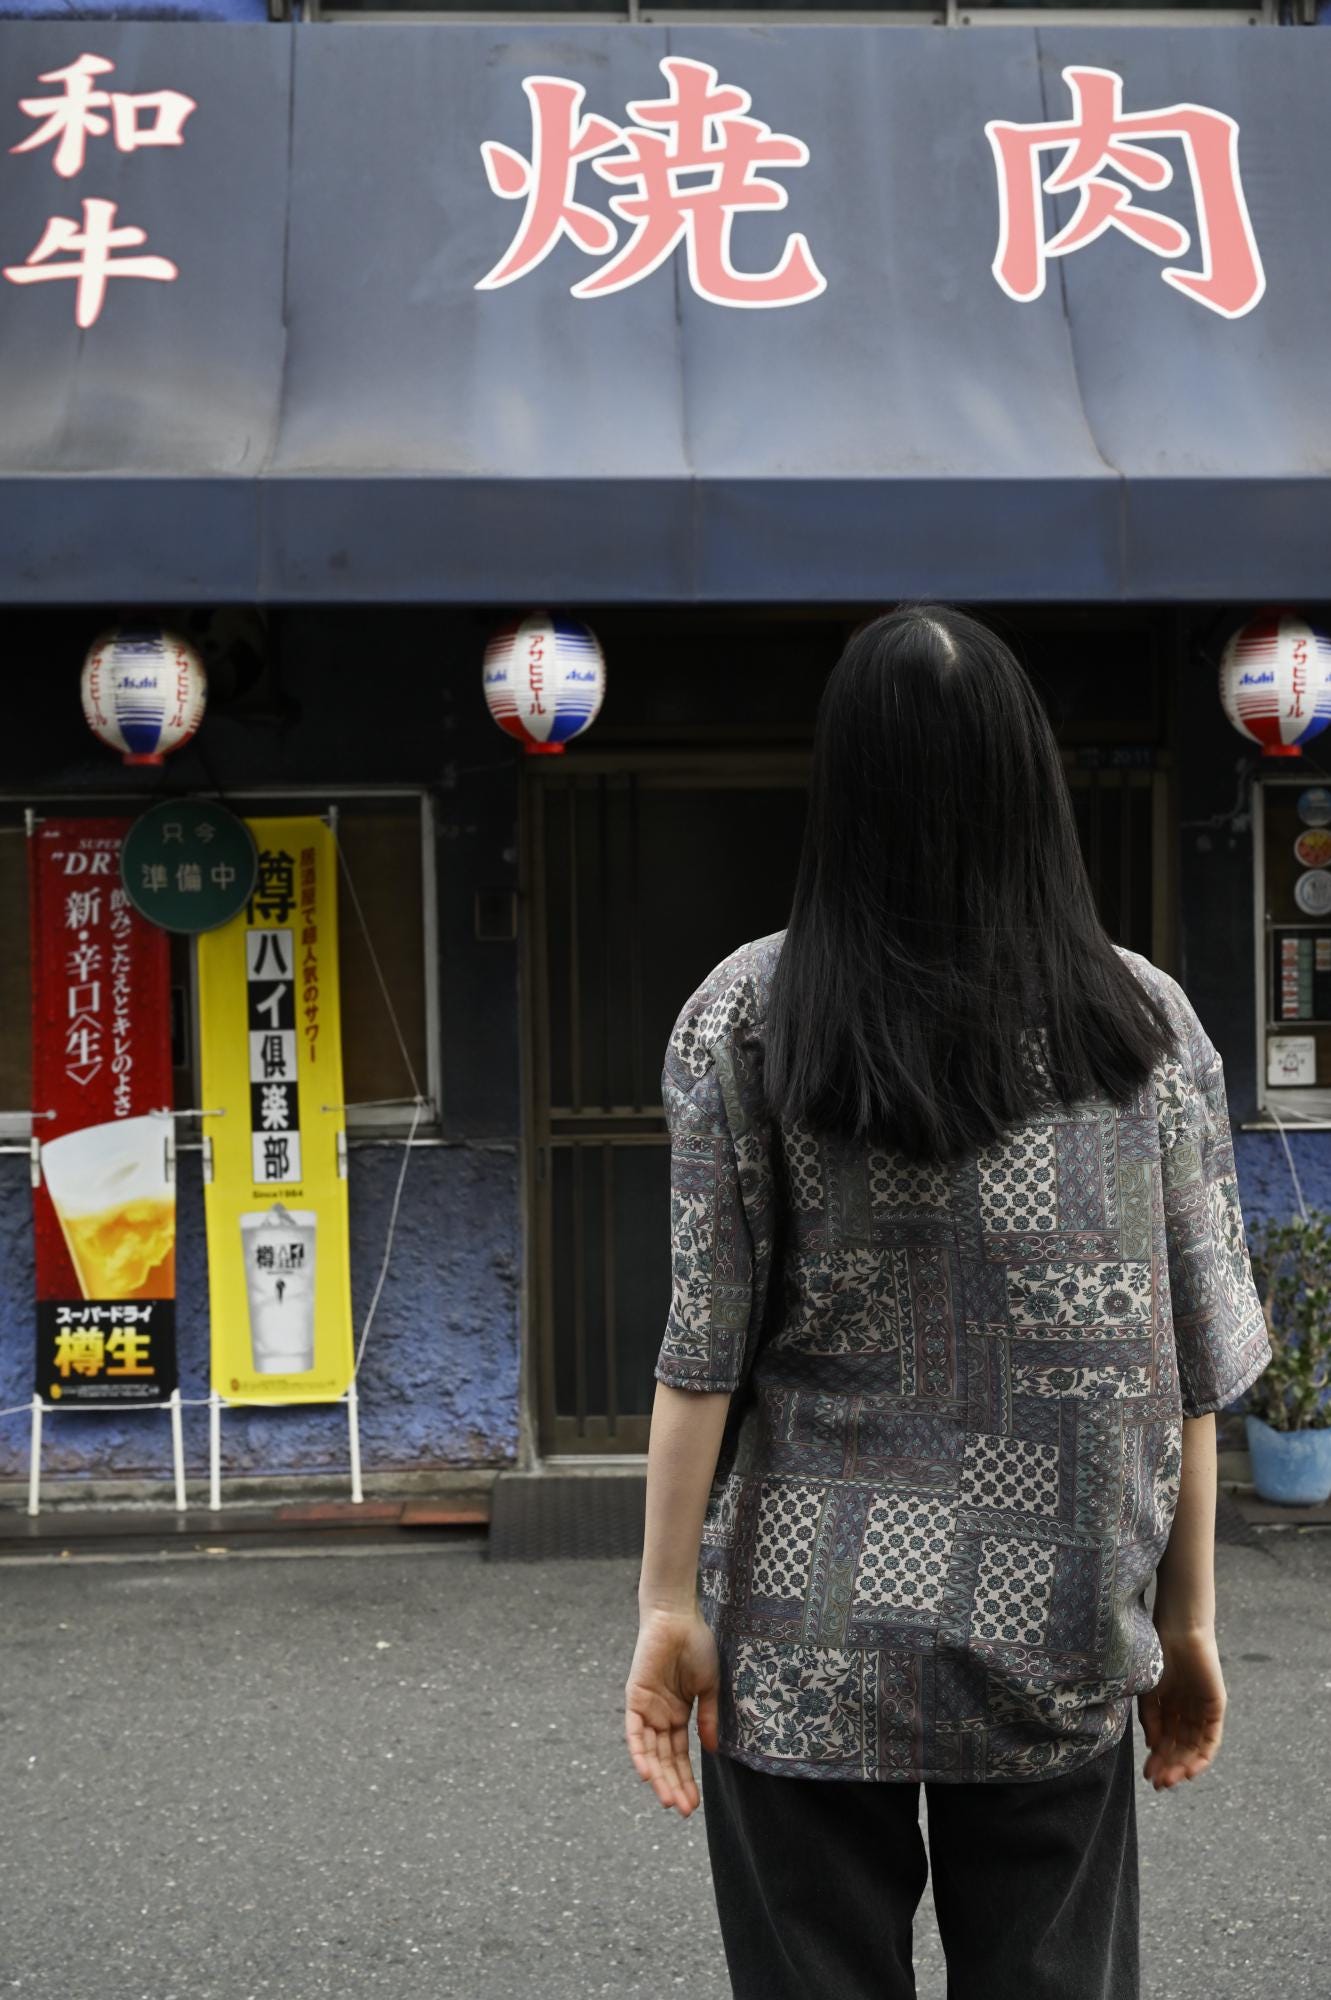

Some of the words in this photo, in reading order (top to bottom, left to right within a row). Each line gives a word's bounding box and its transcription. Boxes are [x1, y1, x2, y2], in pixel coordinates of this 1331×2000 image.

[3, 53, 197, 329] 和牛
[474, 56, 1266, 319] 焼肉
[117, 675, 157, 689] Asahi
[565, 667, 595, 682] Asahi
[1238, 671, 1275, 686] Asahi
[161, 822, 216, 844] 只今
[51, 851, 122, 876] "DR
[141, 861, 236, 894] 準備中
[56, 1305, 152, 1324] スーパードライ
[54, 1326, 155, 1378] 樽生
